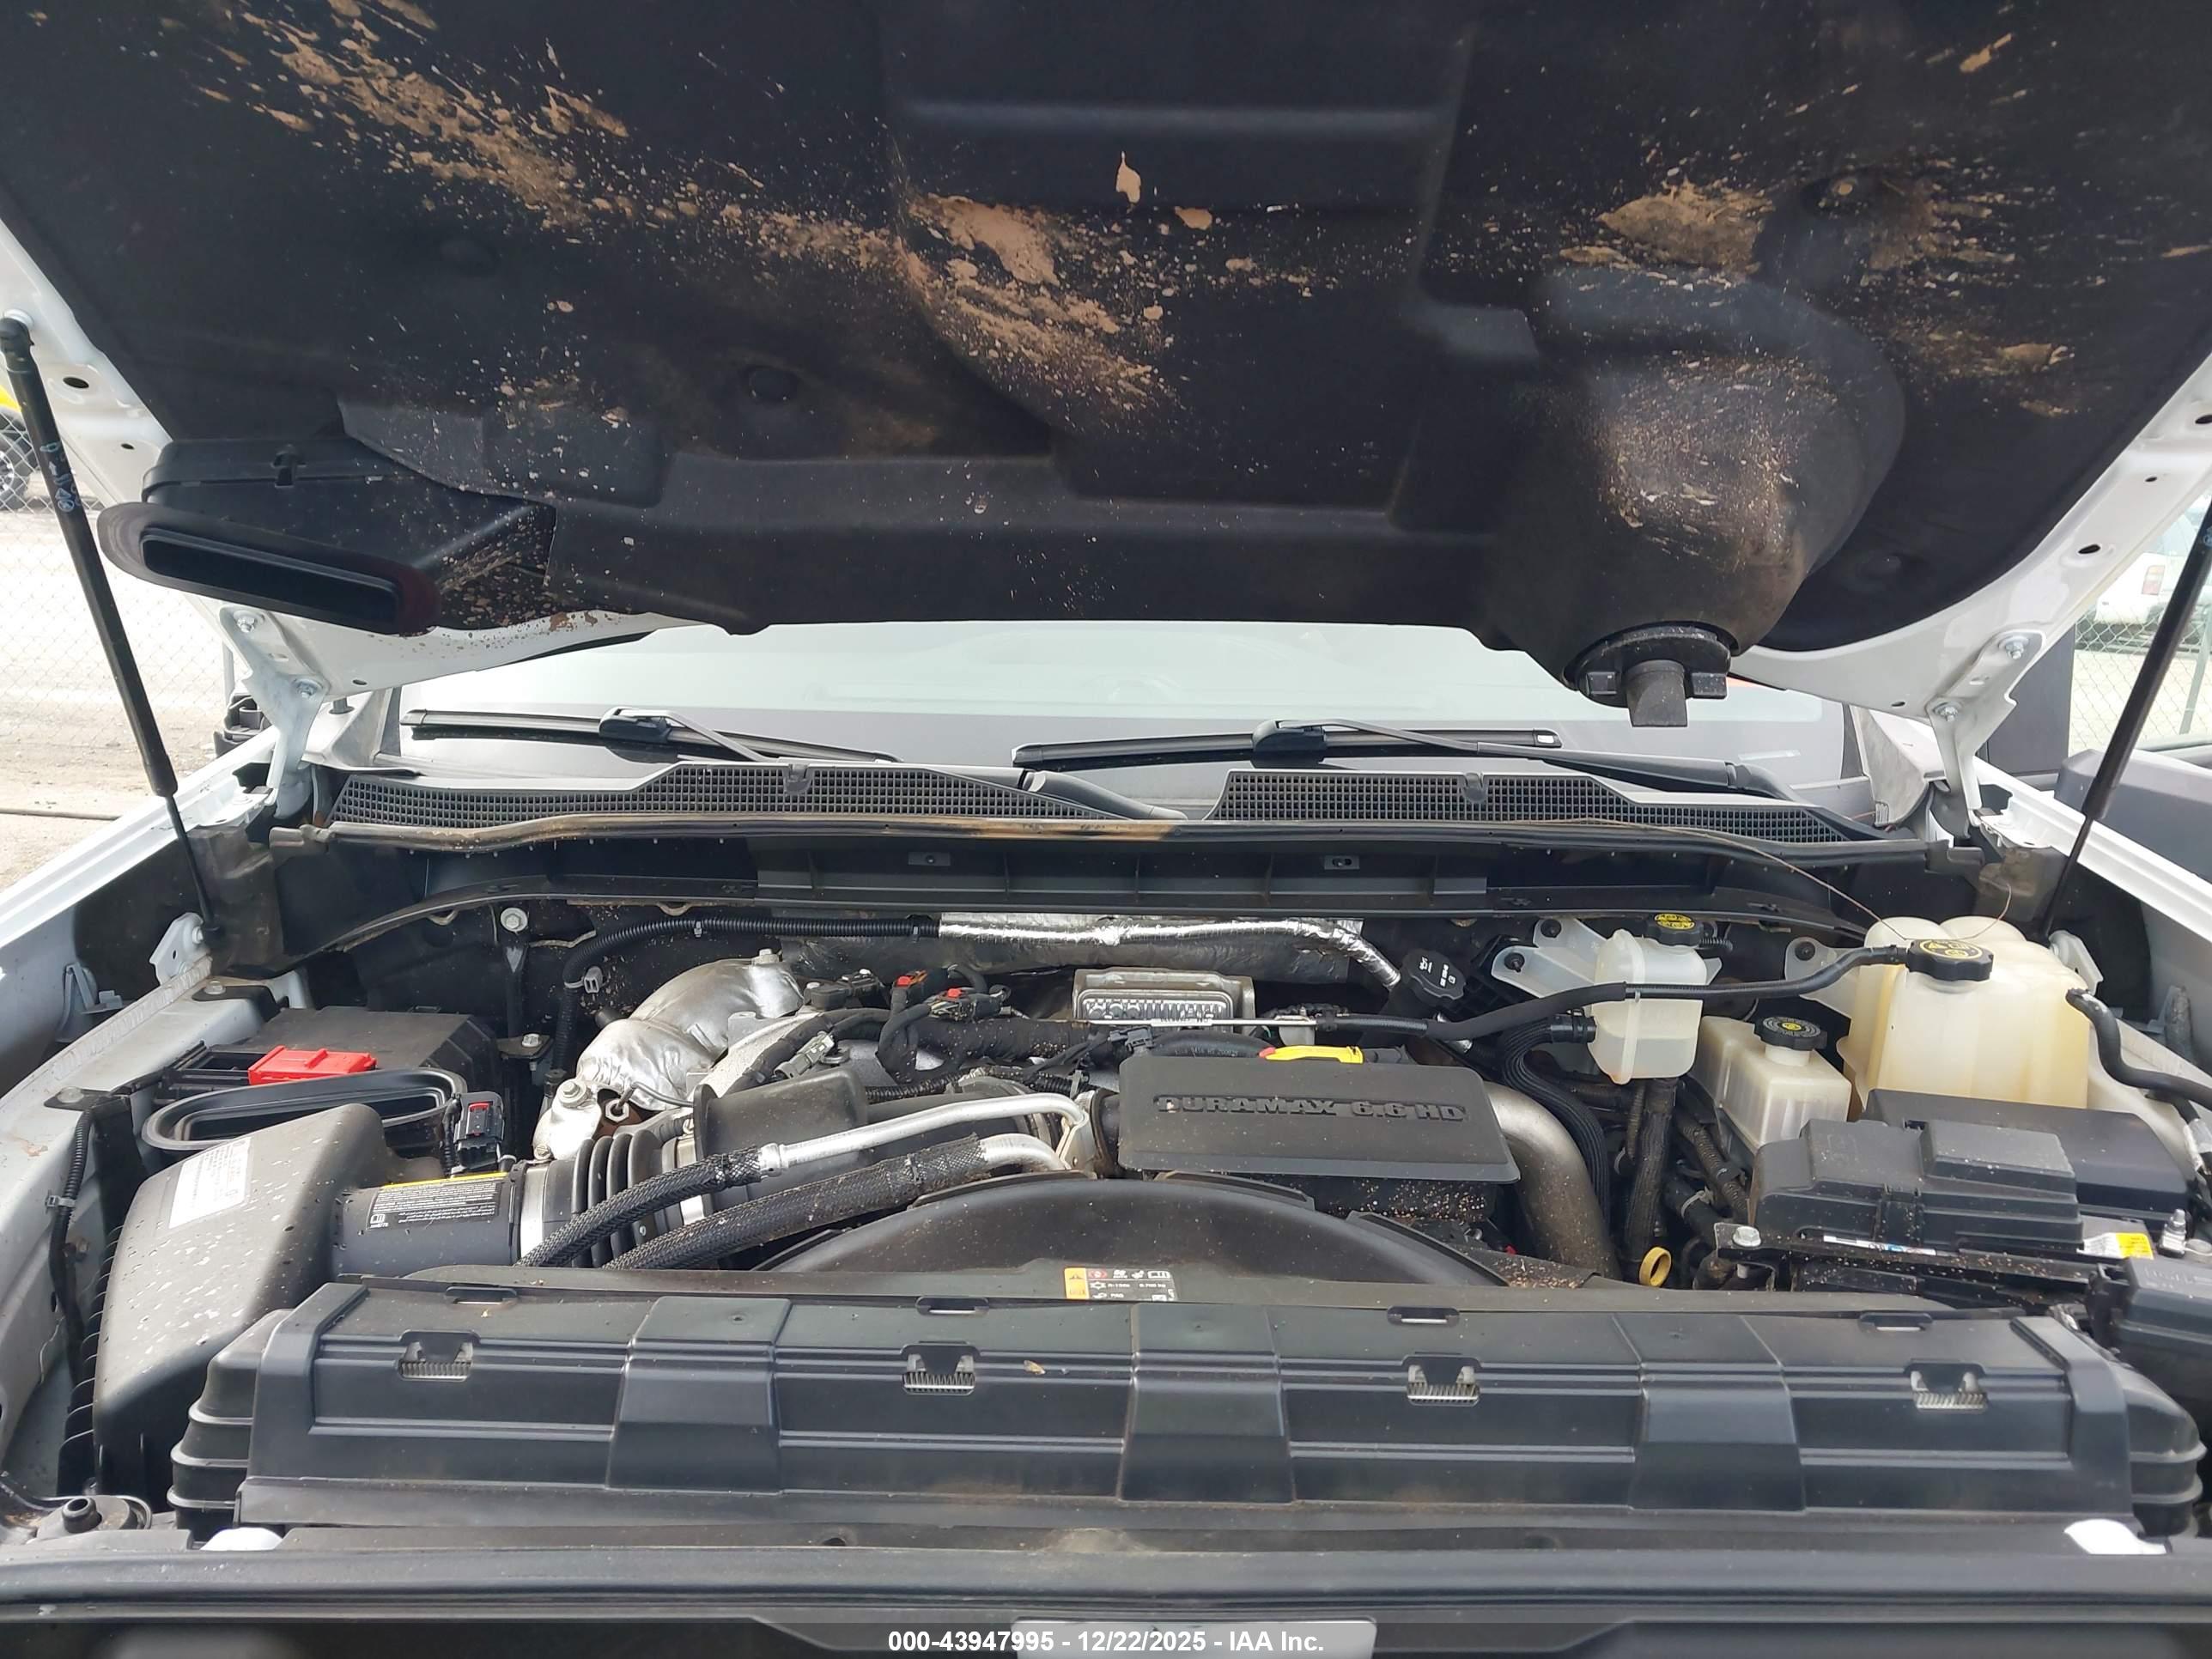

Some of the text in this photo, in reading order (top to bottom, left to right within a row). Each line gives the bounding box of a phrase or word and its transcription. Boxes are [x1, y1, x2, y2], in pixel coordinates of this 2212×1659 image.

[1157, 1096, 1467, 1121] DURAMAX 6.6 HD
